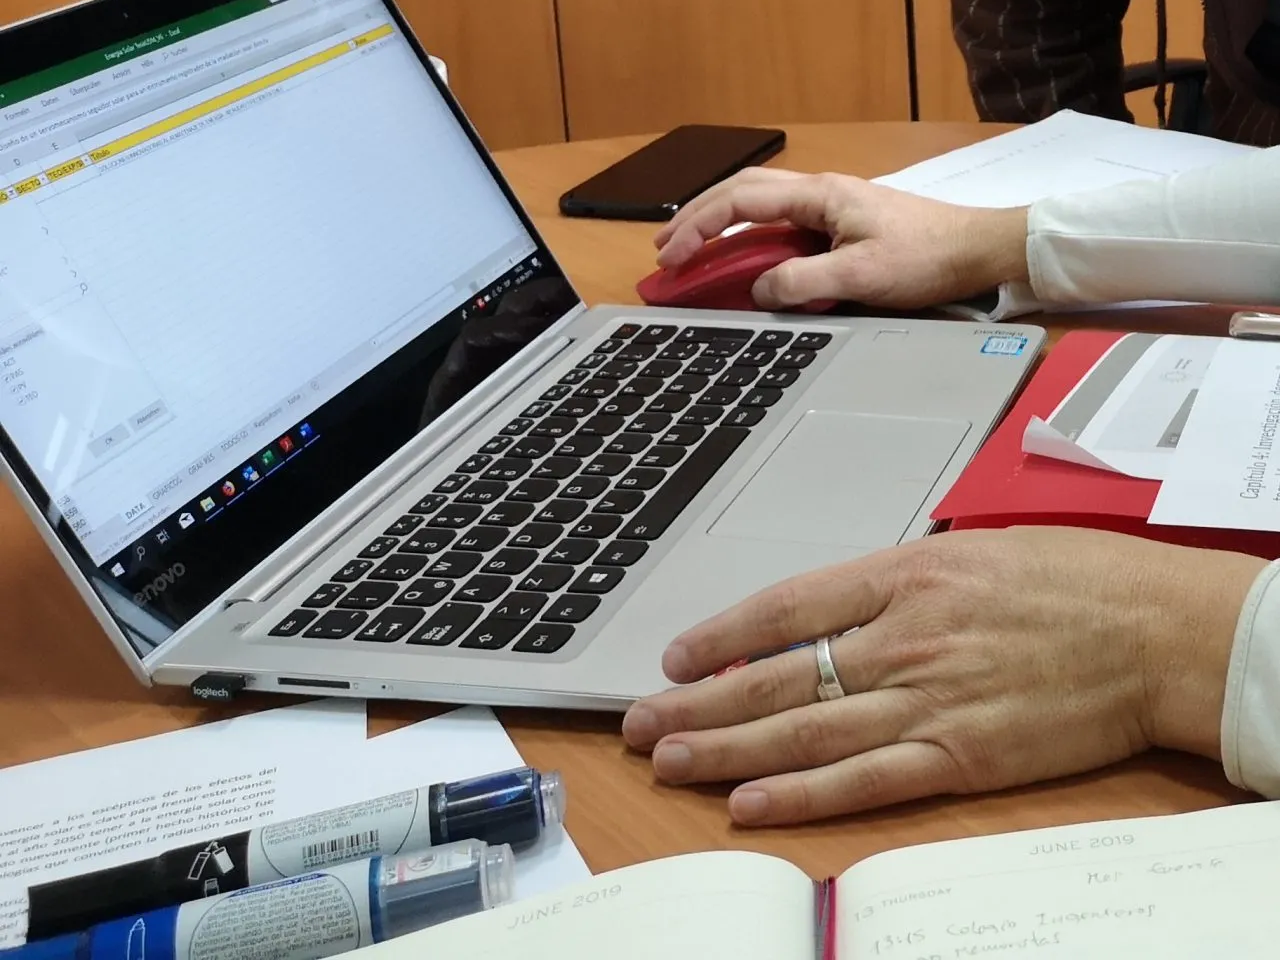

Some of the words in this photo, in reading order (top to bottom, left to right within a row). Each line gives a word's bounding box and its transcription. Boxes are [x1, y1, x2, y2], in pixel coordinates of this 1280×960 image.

[1250, 448, 1270, 461] 4:
[1238, 459, 1269, 499] Capítulo
[123, 500, 147, 520] DATA
[433, 562, 451, 570] W
[192, 686, 228, 699] logitech
[43, 825, 74, 837] solar
[77, 821, 92, 829] es
[94, 810, 126, 824] clave
[129, 805, 158, 817] para
[160, 794, 197, 807] frenar
[200, 788, 228, 799] este
[66, 812, 84, 821] los
[91, 793, 156, 816] escépticos
[161, 788, 179, 797] de
[184, 783, 202, 792] los
[208, 772, 252, 787] efectos
[257, 765, 278, 776] del
[19, 839, 100, 863] nuevamente
[104, 825, 152, 844] (primer
[154, 816, 194, 830] hecho
[197, 804, 251, 820] histórico
[254, 798, 274, 808] fue
[52, 832, 85, 845] 2050
[89, 823, 123, 836] tener
[140, 815, 151, 823] la
[156, 803, 202, 820] energía
[207, 796, 237, 808] solar
[240, 786, 277, 801] como
[43, 858, 69, 869] que
[72, 839, 143, 864] convierten
[161, 820, 220, 839] radiación
[223, 813, 254, 825] solar
[257, 809, 274, 817] en
[1028, 838, 1081, 856] JUNE
[1088, 832, 1136, 849] 2019
[506, 900, 565, 930] JUNE
[569, 883, 625, 912] 2019
[880, 883, 953, 910] THURSDAY
